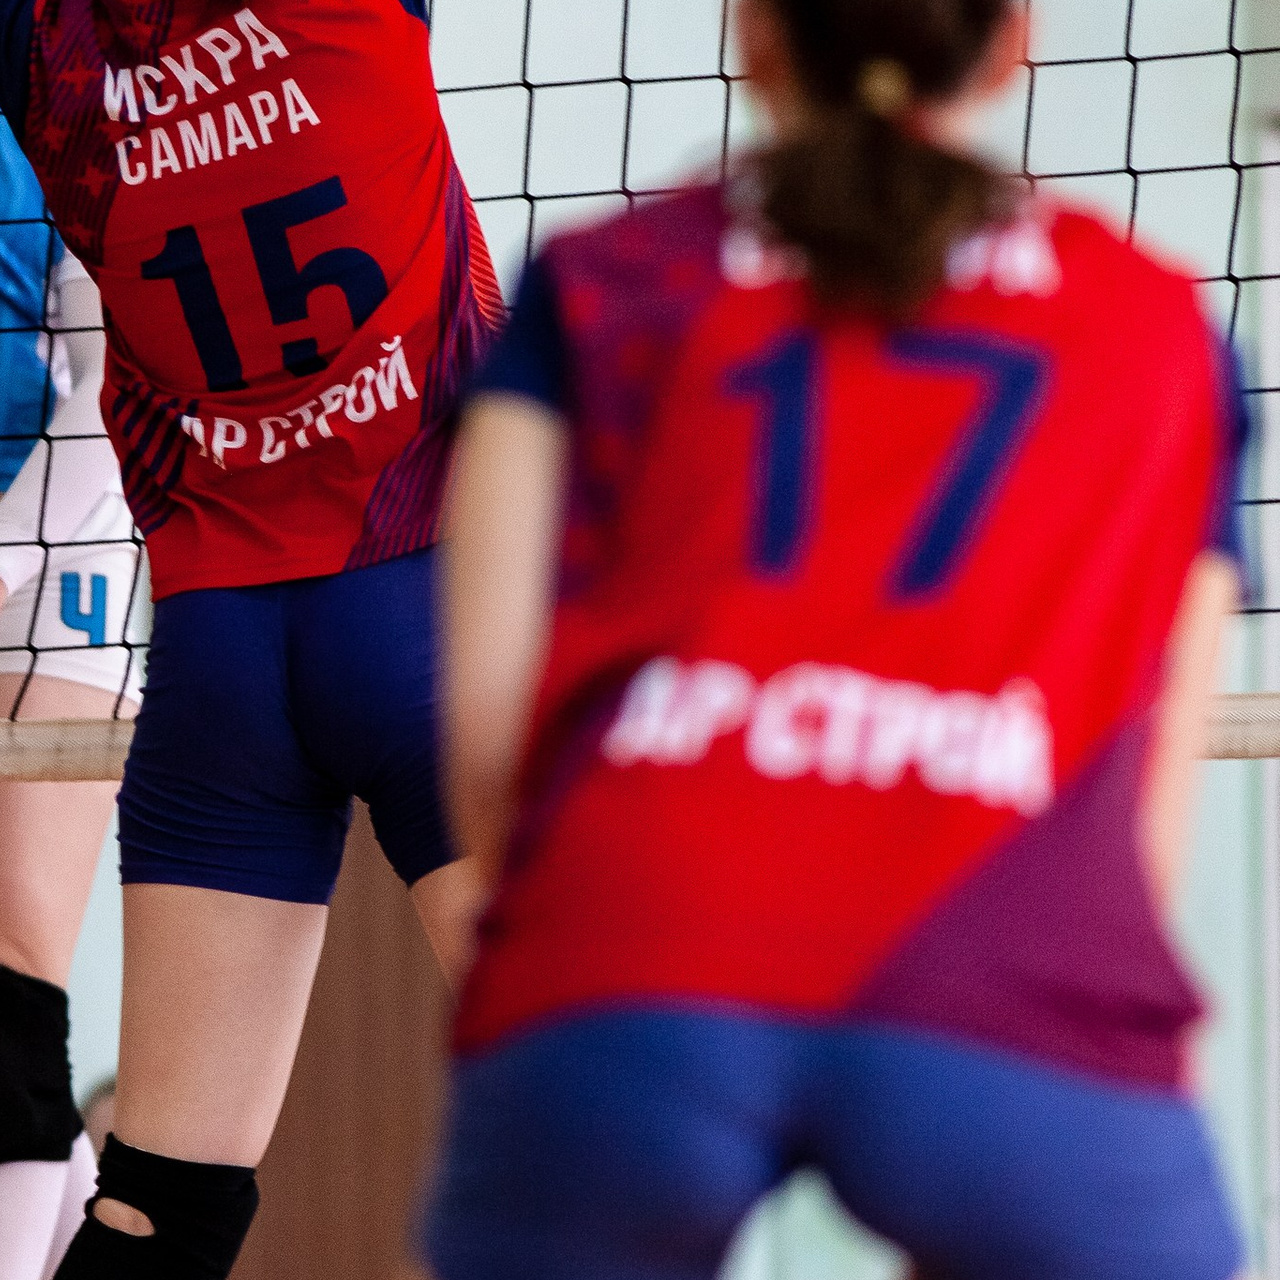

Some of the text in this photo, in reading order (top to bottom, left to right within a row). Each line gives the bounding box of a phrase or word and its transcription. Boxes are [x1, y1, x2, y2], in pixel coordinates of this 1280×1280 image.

[104, 7, 290, 123] ИСКРА
[115, 77, 322, 186] САМАРА
[141, 176, 390, 394] 15
[258, 334, 420, 464] СТРОЙ
[722, 325, 1055, 605] 17
[60, 571, 107, 647] 4
